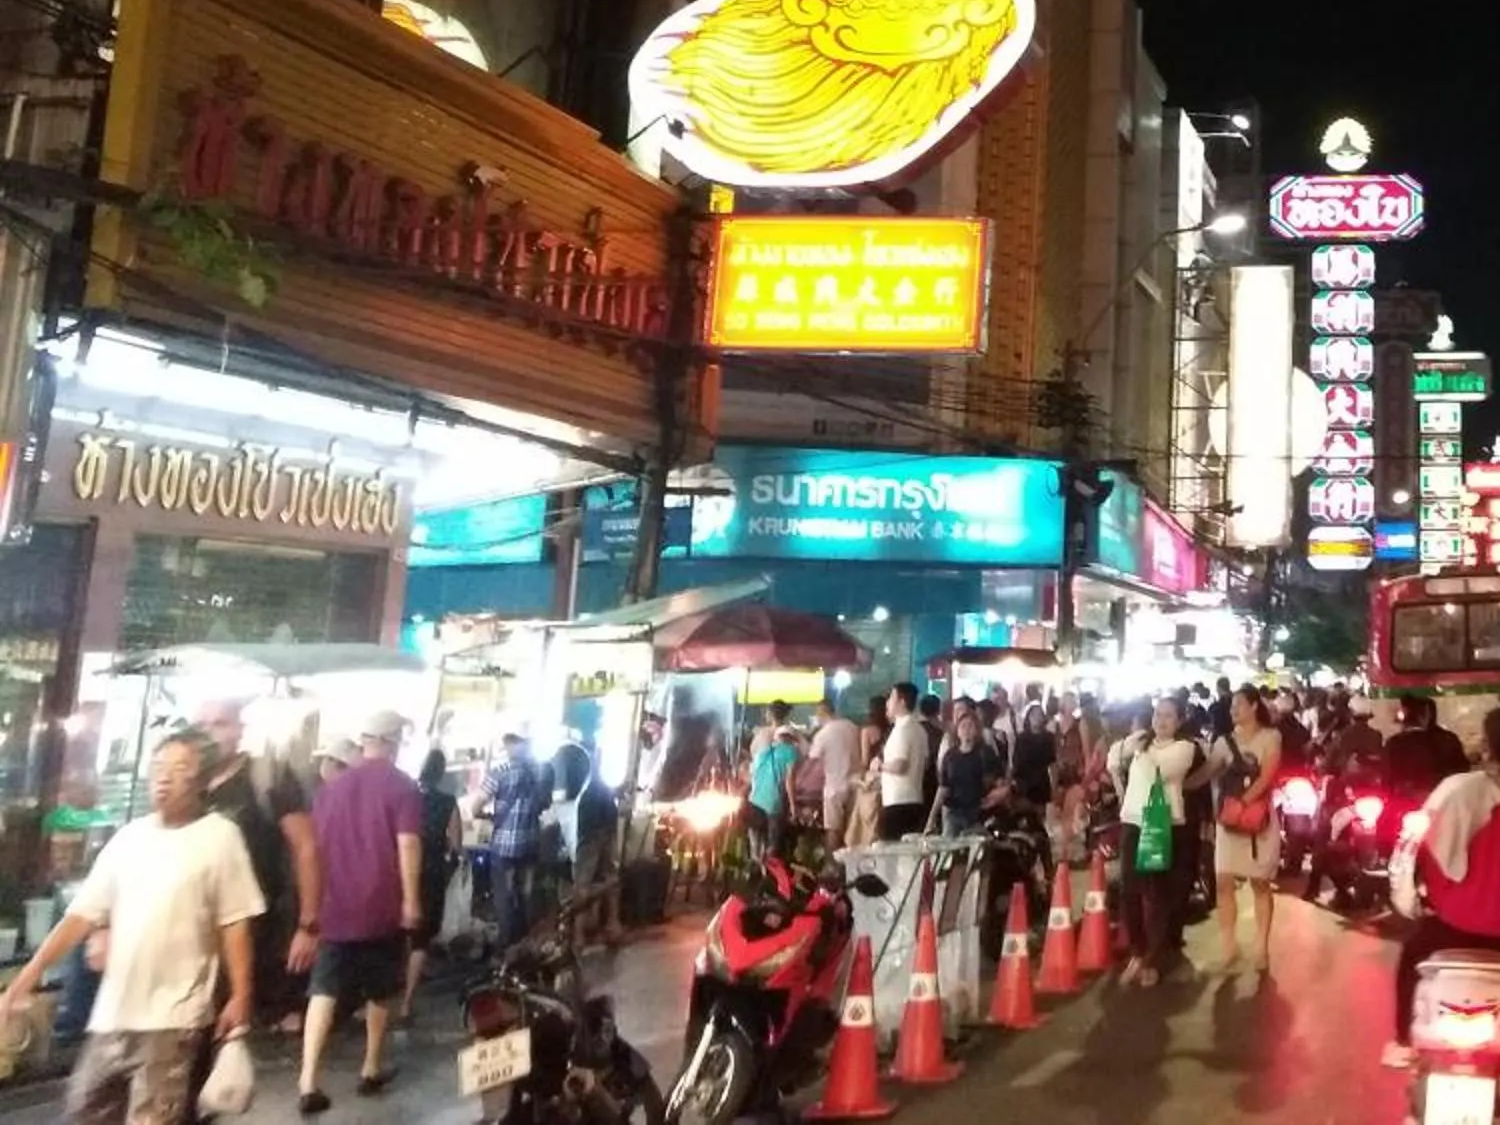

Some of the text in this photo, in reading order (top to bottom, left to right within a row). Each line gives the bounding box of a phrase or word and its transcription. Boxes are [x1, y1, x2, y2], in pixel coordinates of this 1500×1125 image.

[751, 471, 1016, 520] ธนาคารกรุงไ
[870, 520, 924, 541] BANK
